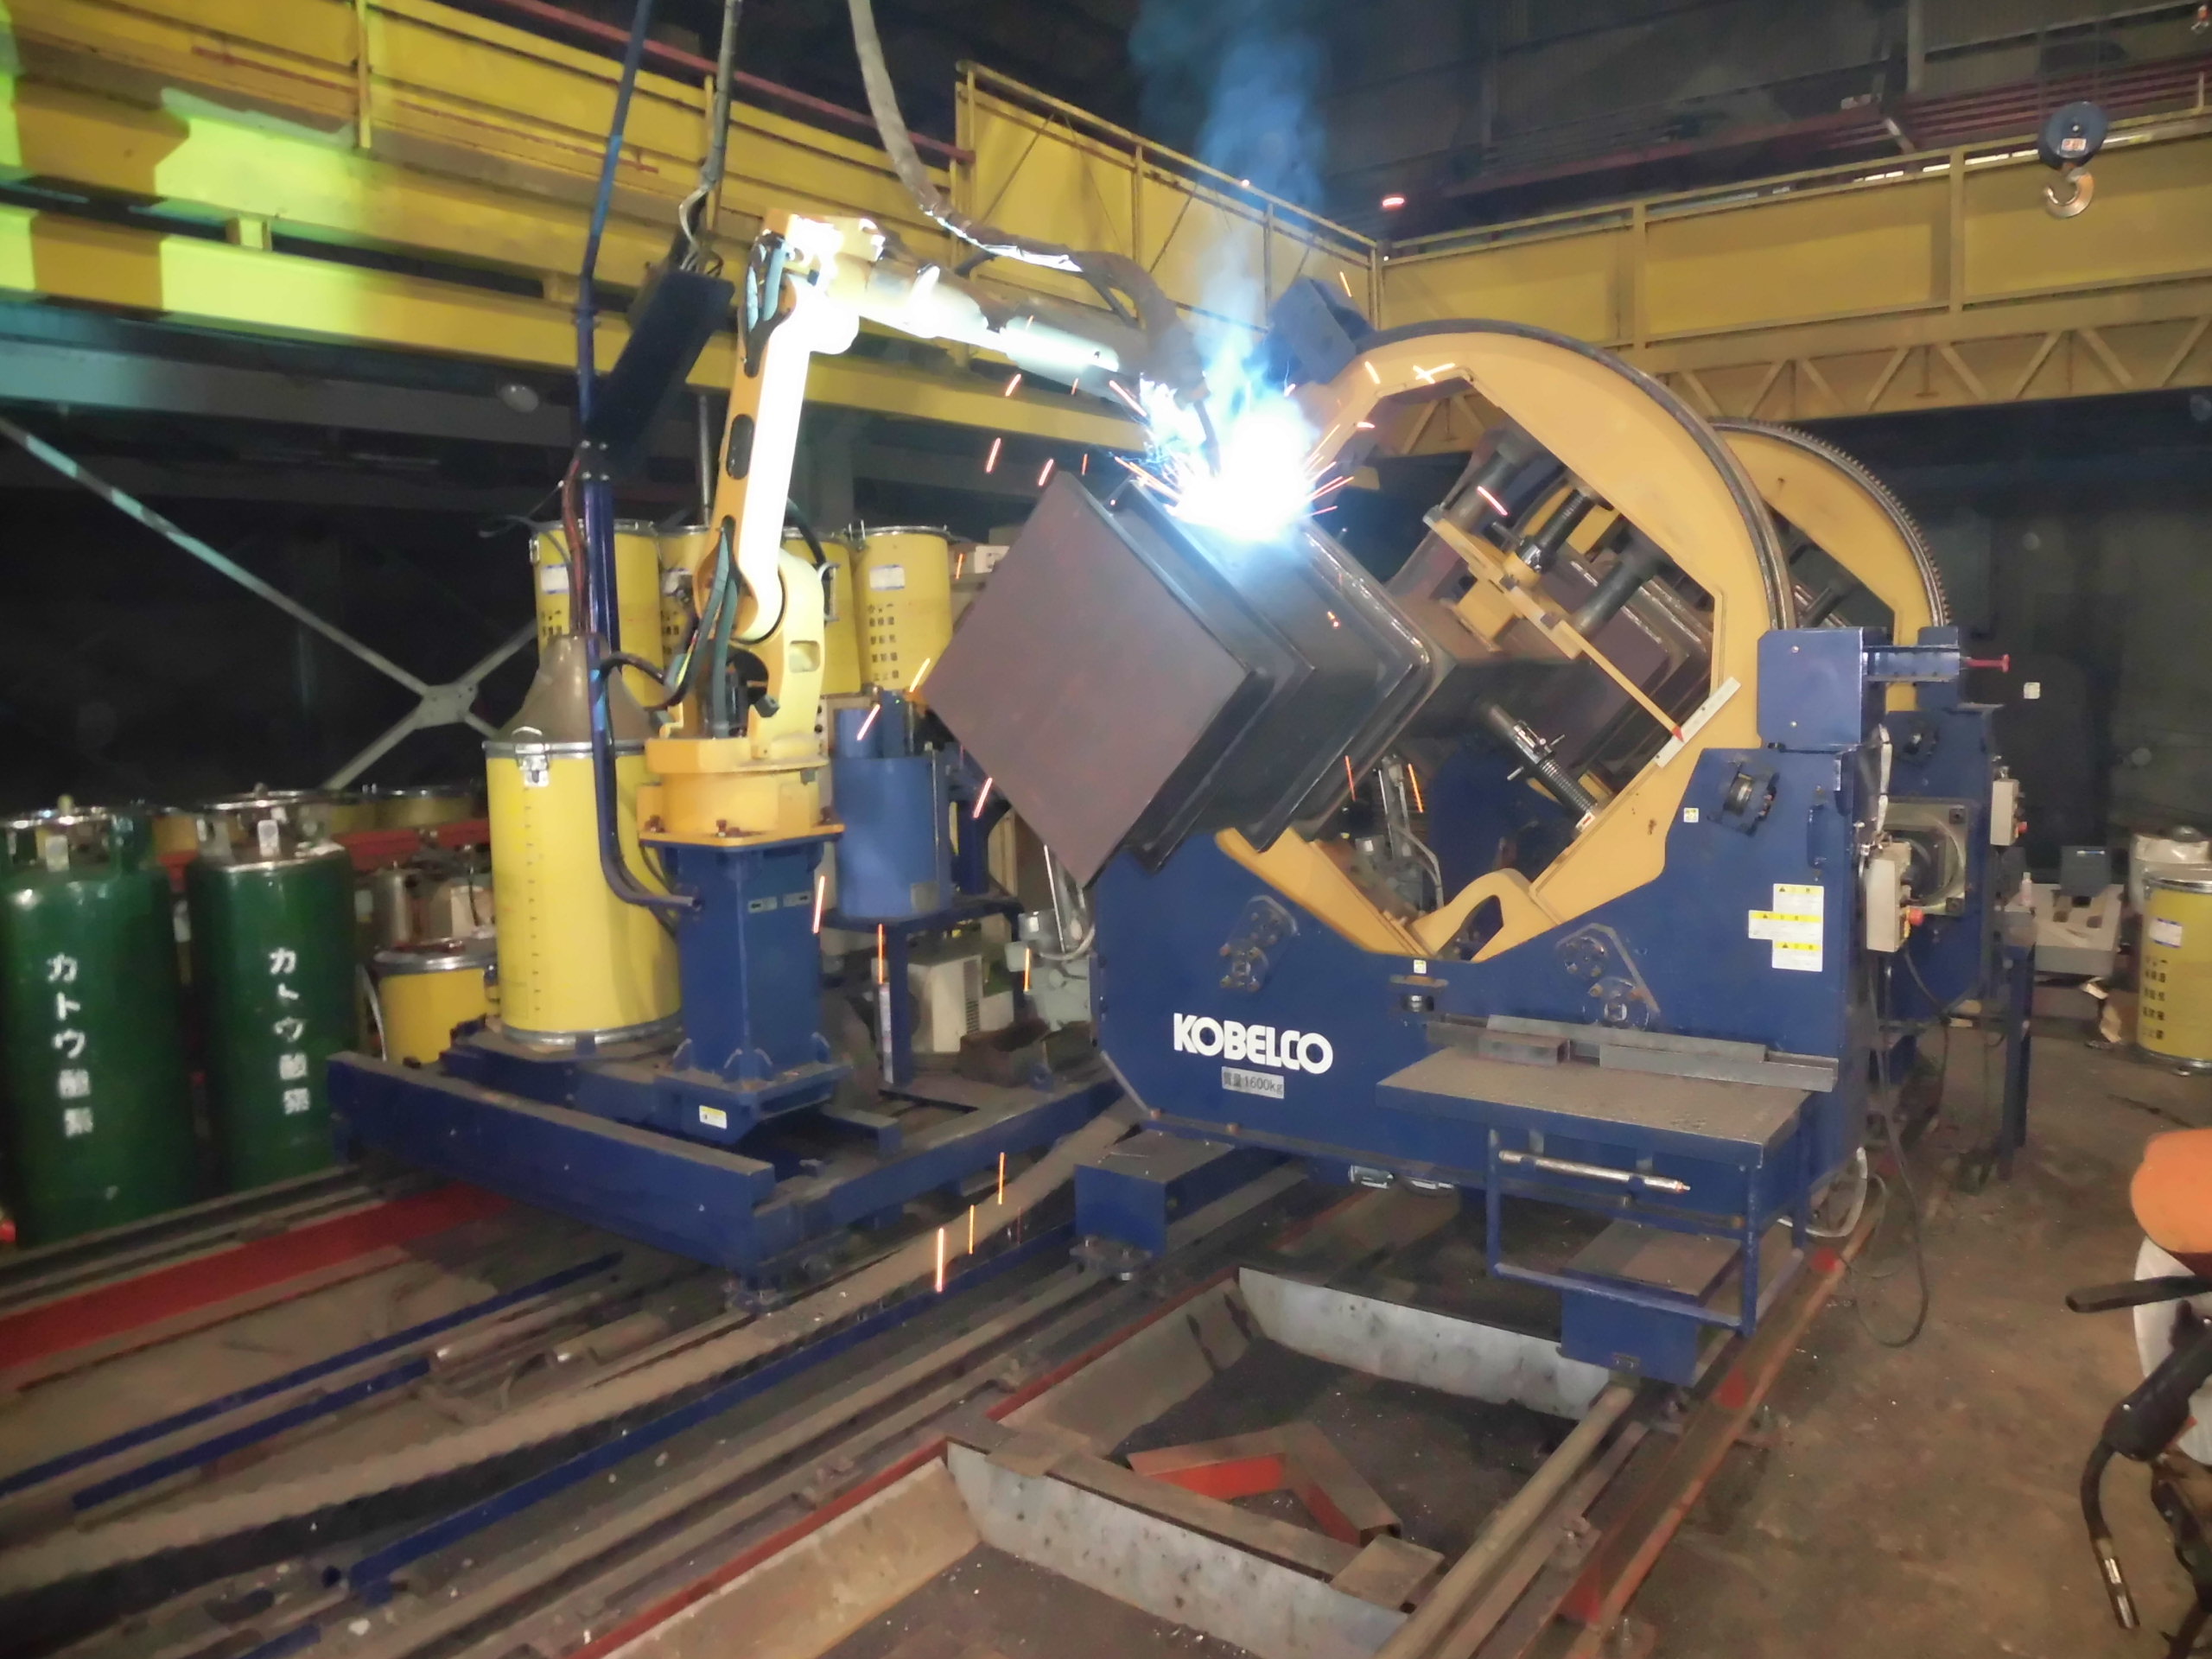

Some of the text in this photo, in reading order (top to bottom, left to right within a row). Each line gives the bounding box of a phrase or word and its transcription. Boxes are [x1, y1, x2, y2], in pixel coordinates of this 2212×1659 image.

[46, 951, 93, 1137] カトウ
[268, 947, 310, 1115] カトウ
[1173, 1013, 1333, 1074] KOBELCO
[1223, 1071, 1283, 1095] 1600kg
